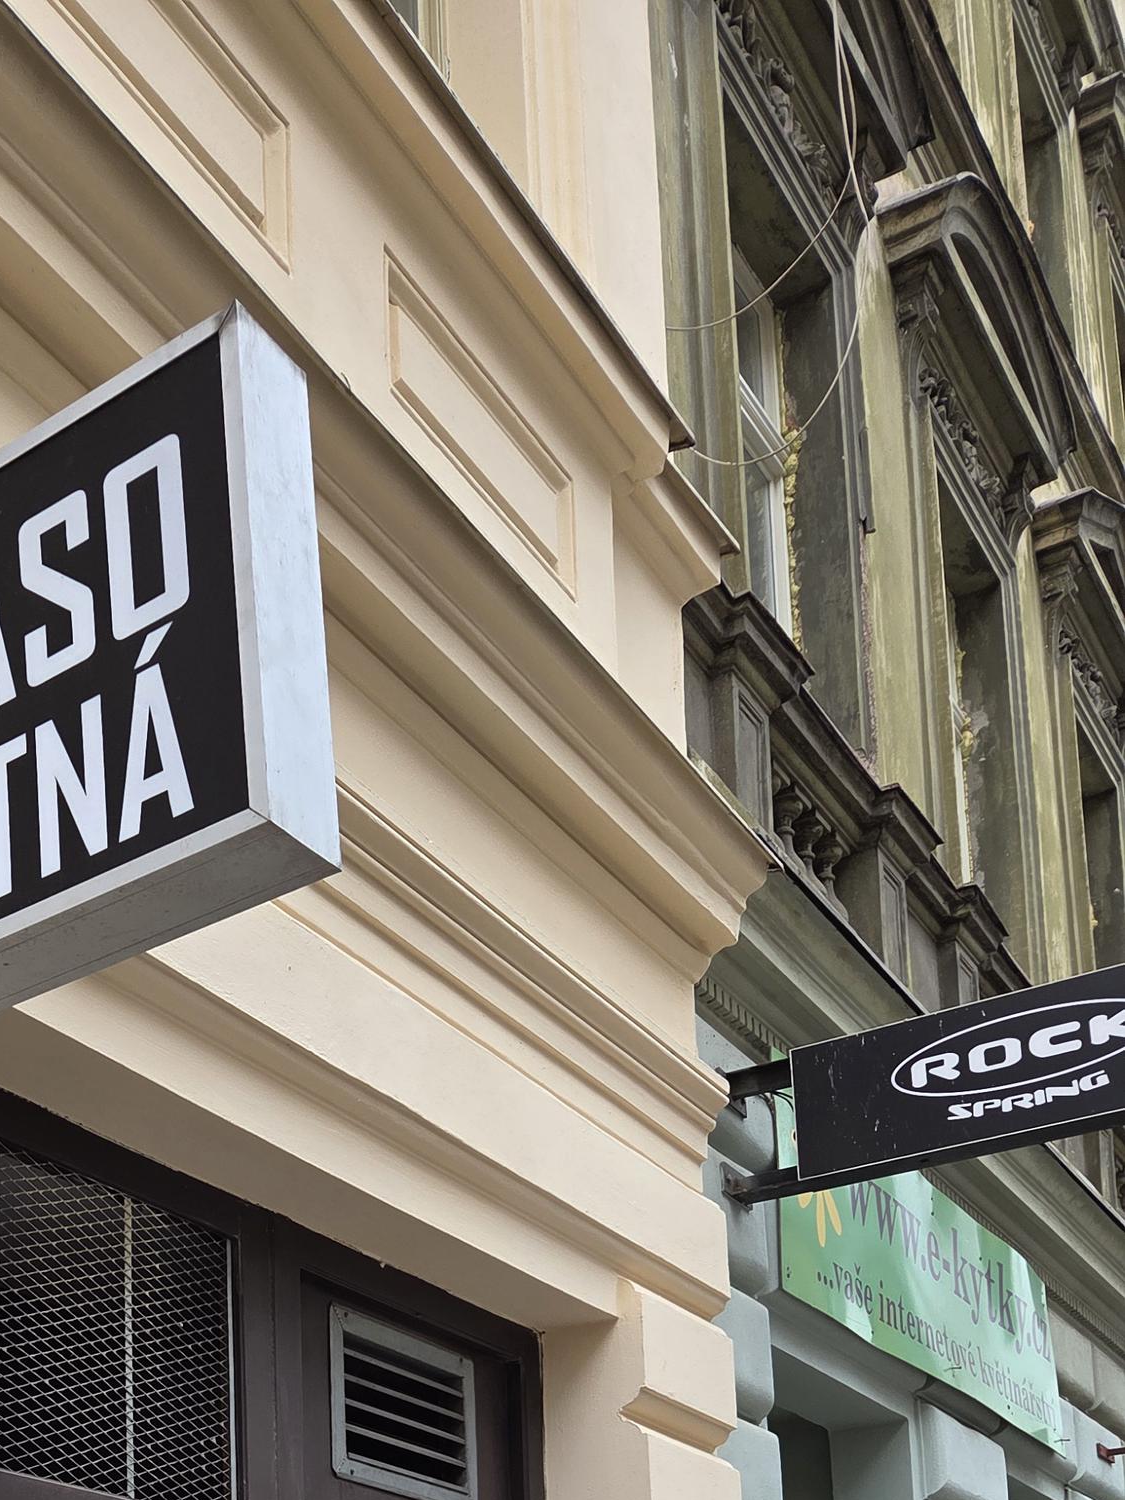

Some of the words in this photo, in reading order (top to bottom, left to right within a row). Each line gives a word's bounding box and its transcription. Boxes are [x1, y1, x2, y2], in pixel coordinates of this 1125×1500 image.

[911, 1010, 1125, 1088] ROCK
[947, 1069, 1110, 1121] SPRING
[878, 1280, 977, 1378] internetové
